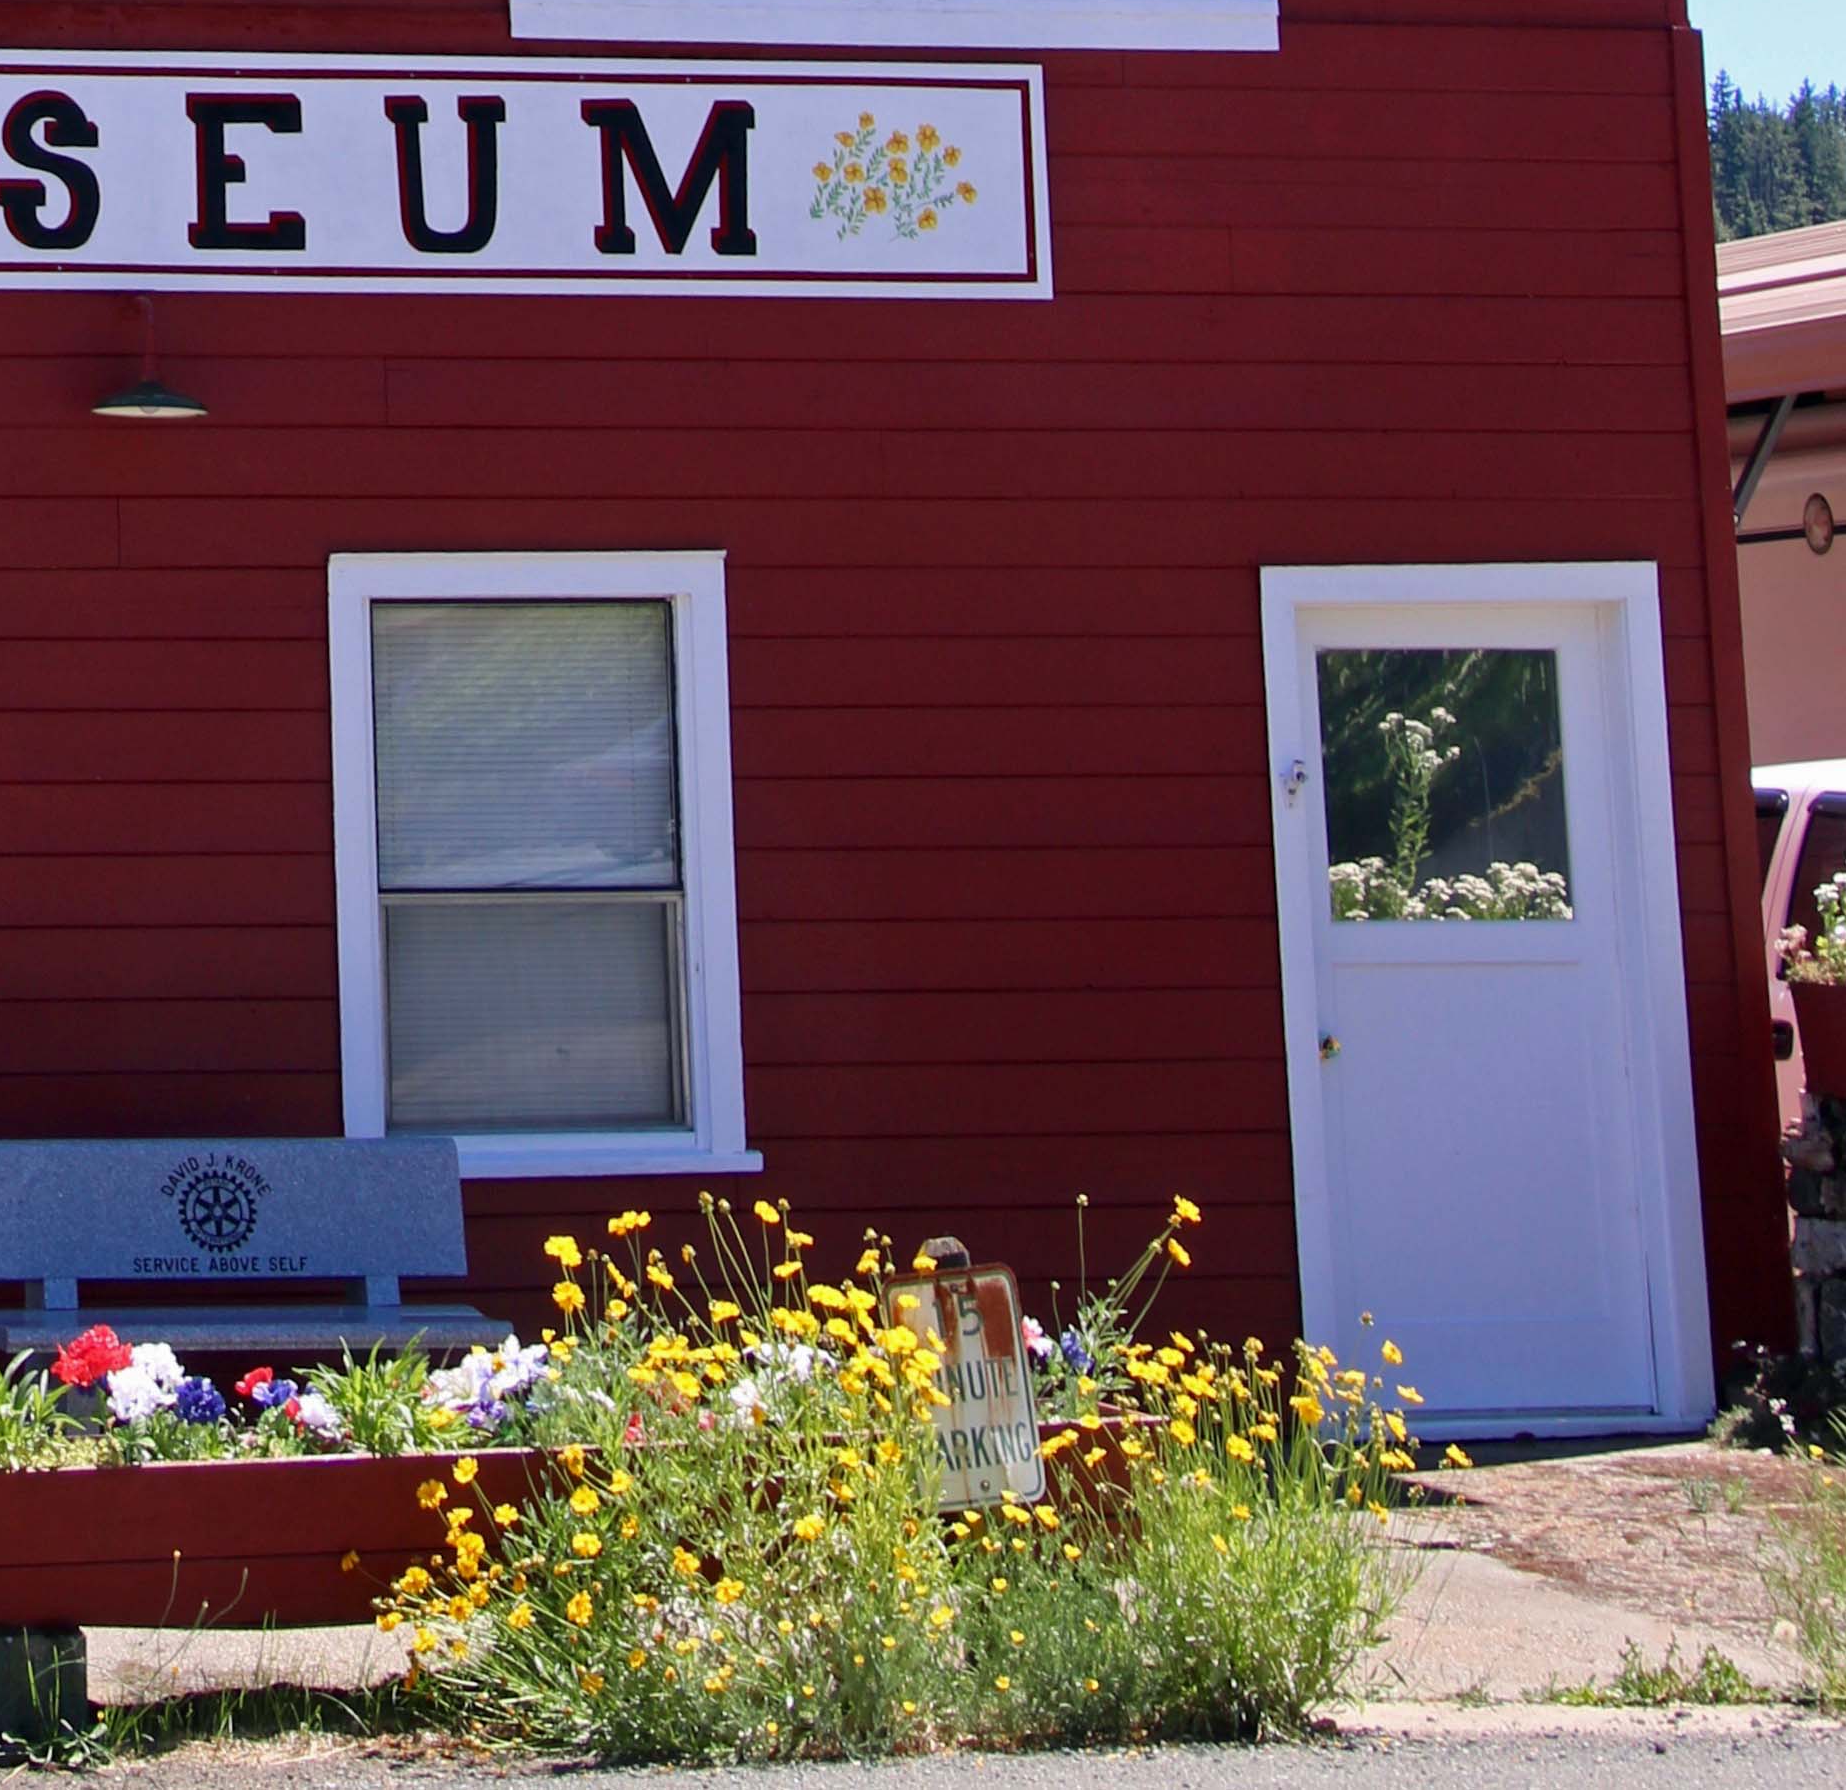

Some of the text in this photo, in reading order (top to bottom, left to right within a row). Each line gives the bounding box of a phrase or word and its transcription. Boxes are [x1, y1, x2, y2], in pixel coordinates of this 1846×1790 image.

[160, 1156, 200, 1198] DAVID
[225, 1154, 273, 1198] KRONE
[133, 1257, 307, 1273] SERVICE ABOVE SELF
[933, 1421, 1032, 1472] ARKING
